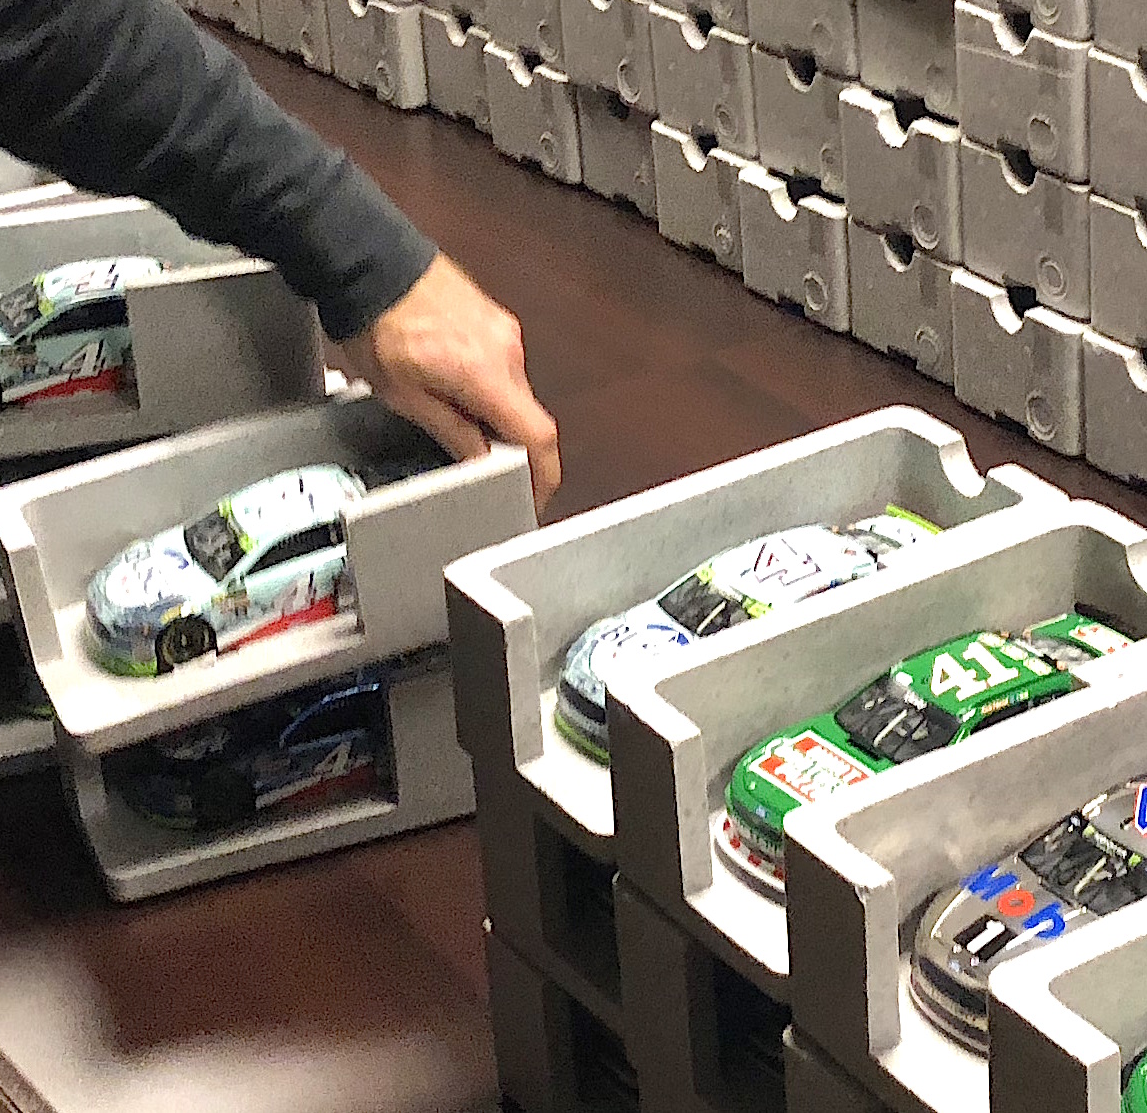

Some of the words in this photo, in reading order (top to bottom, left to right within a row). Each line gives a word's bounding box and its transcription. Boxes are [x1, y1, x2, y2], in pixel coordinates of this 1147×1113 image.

[59, 338, 109, 381] 4
[753, 537, 823, 586] 4
[930, 641, 1020, 702] 41
[967, 919, 1006, 954] 1
